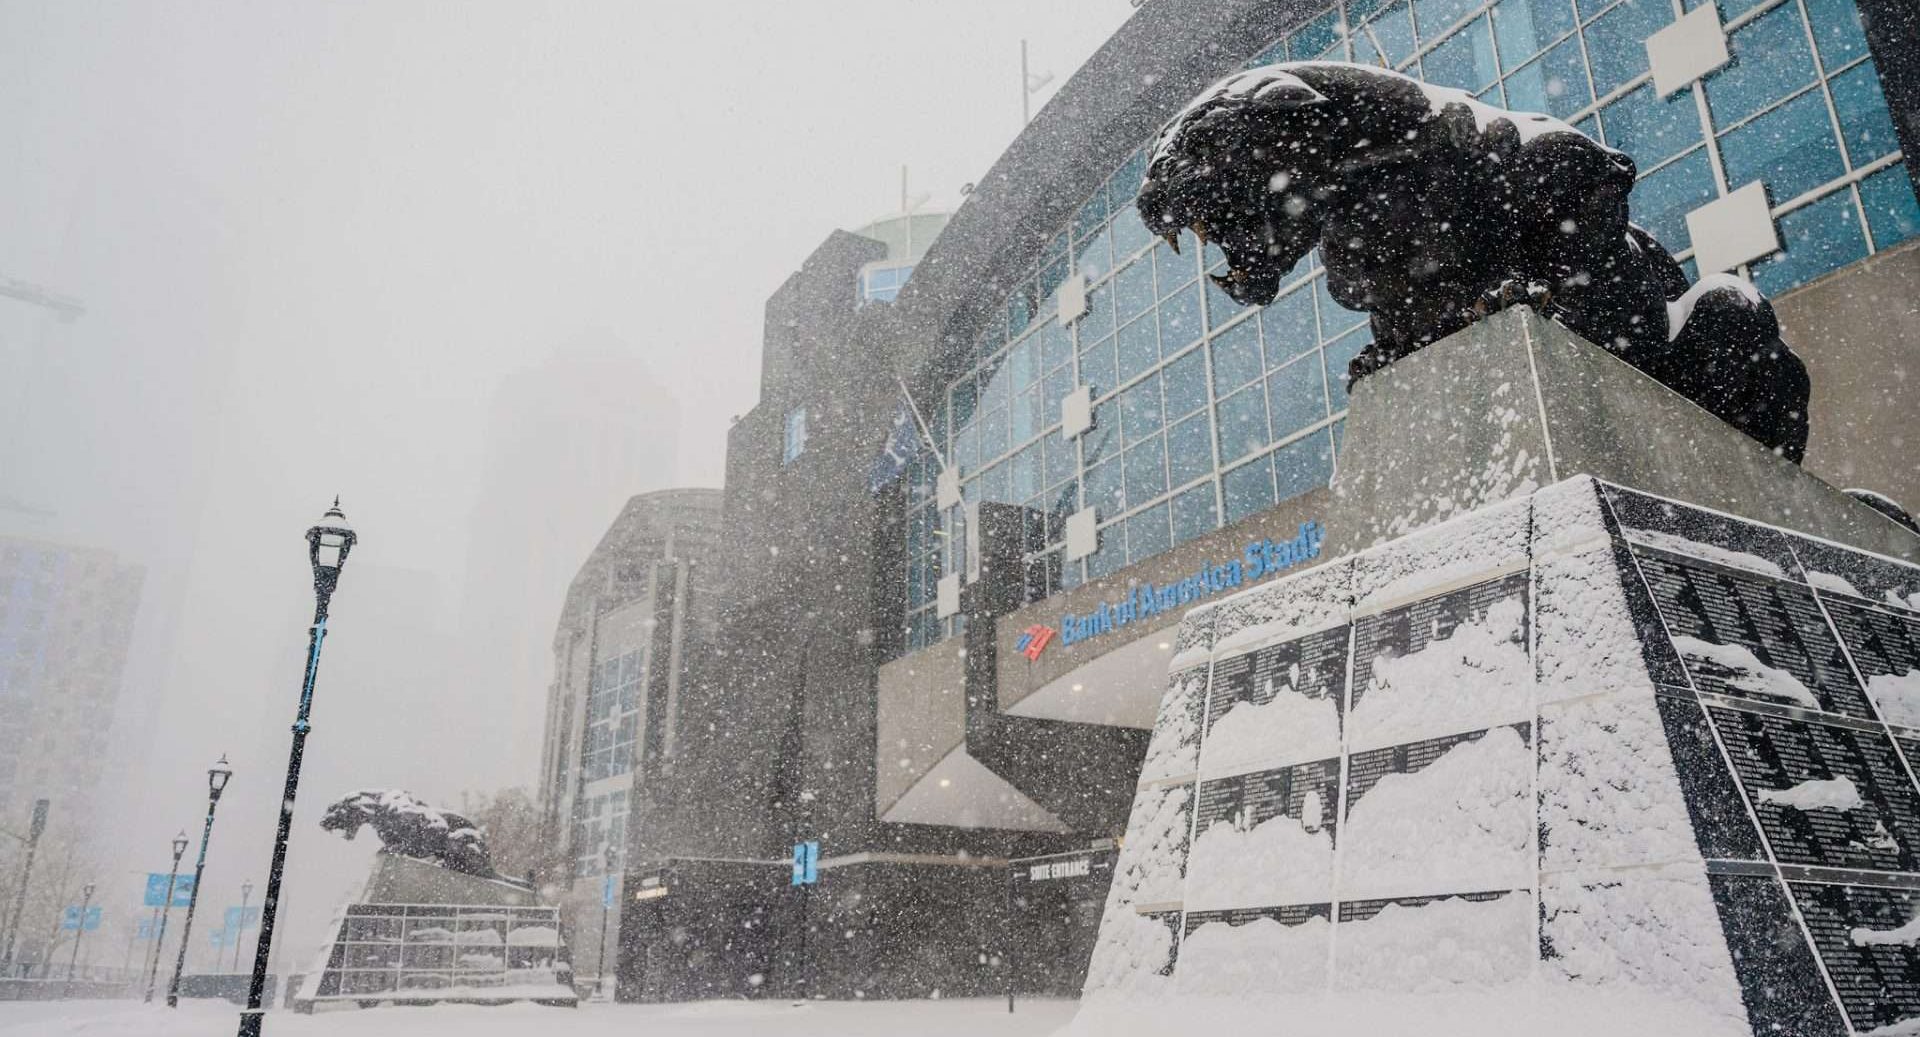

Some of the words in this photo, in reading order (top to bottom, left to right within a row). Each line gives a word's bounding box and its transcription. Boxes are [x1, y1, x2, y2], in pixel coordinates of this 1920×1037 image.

[1061, 600, 1112, 647] Bank
[1115, 586, 1137, 628] of
[1139, 559, 1243, 619] America
